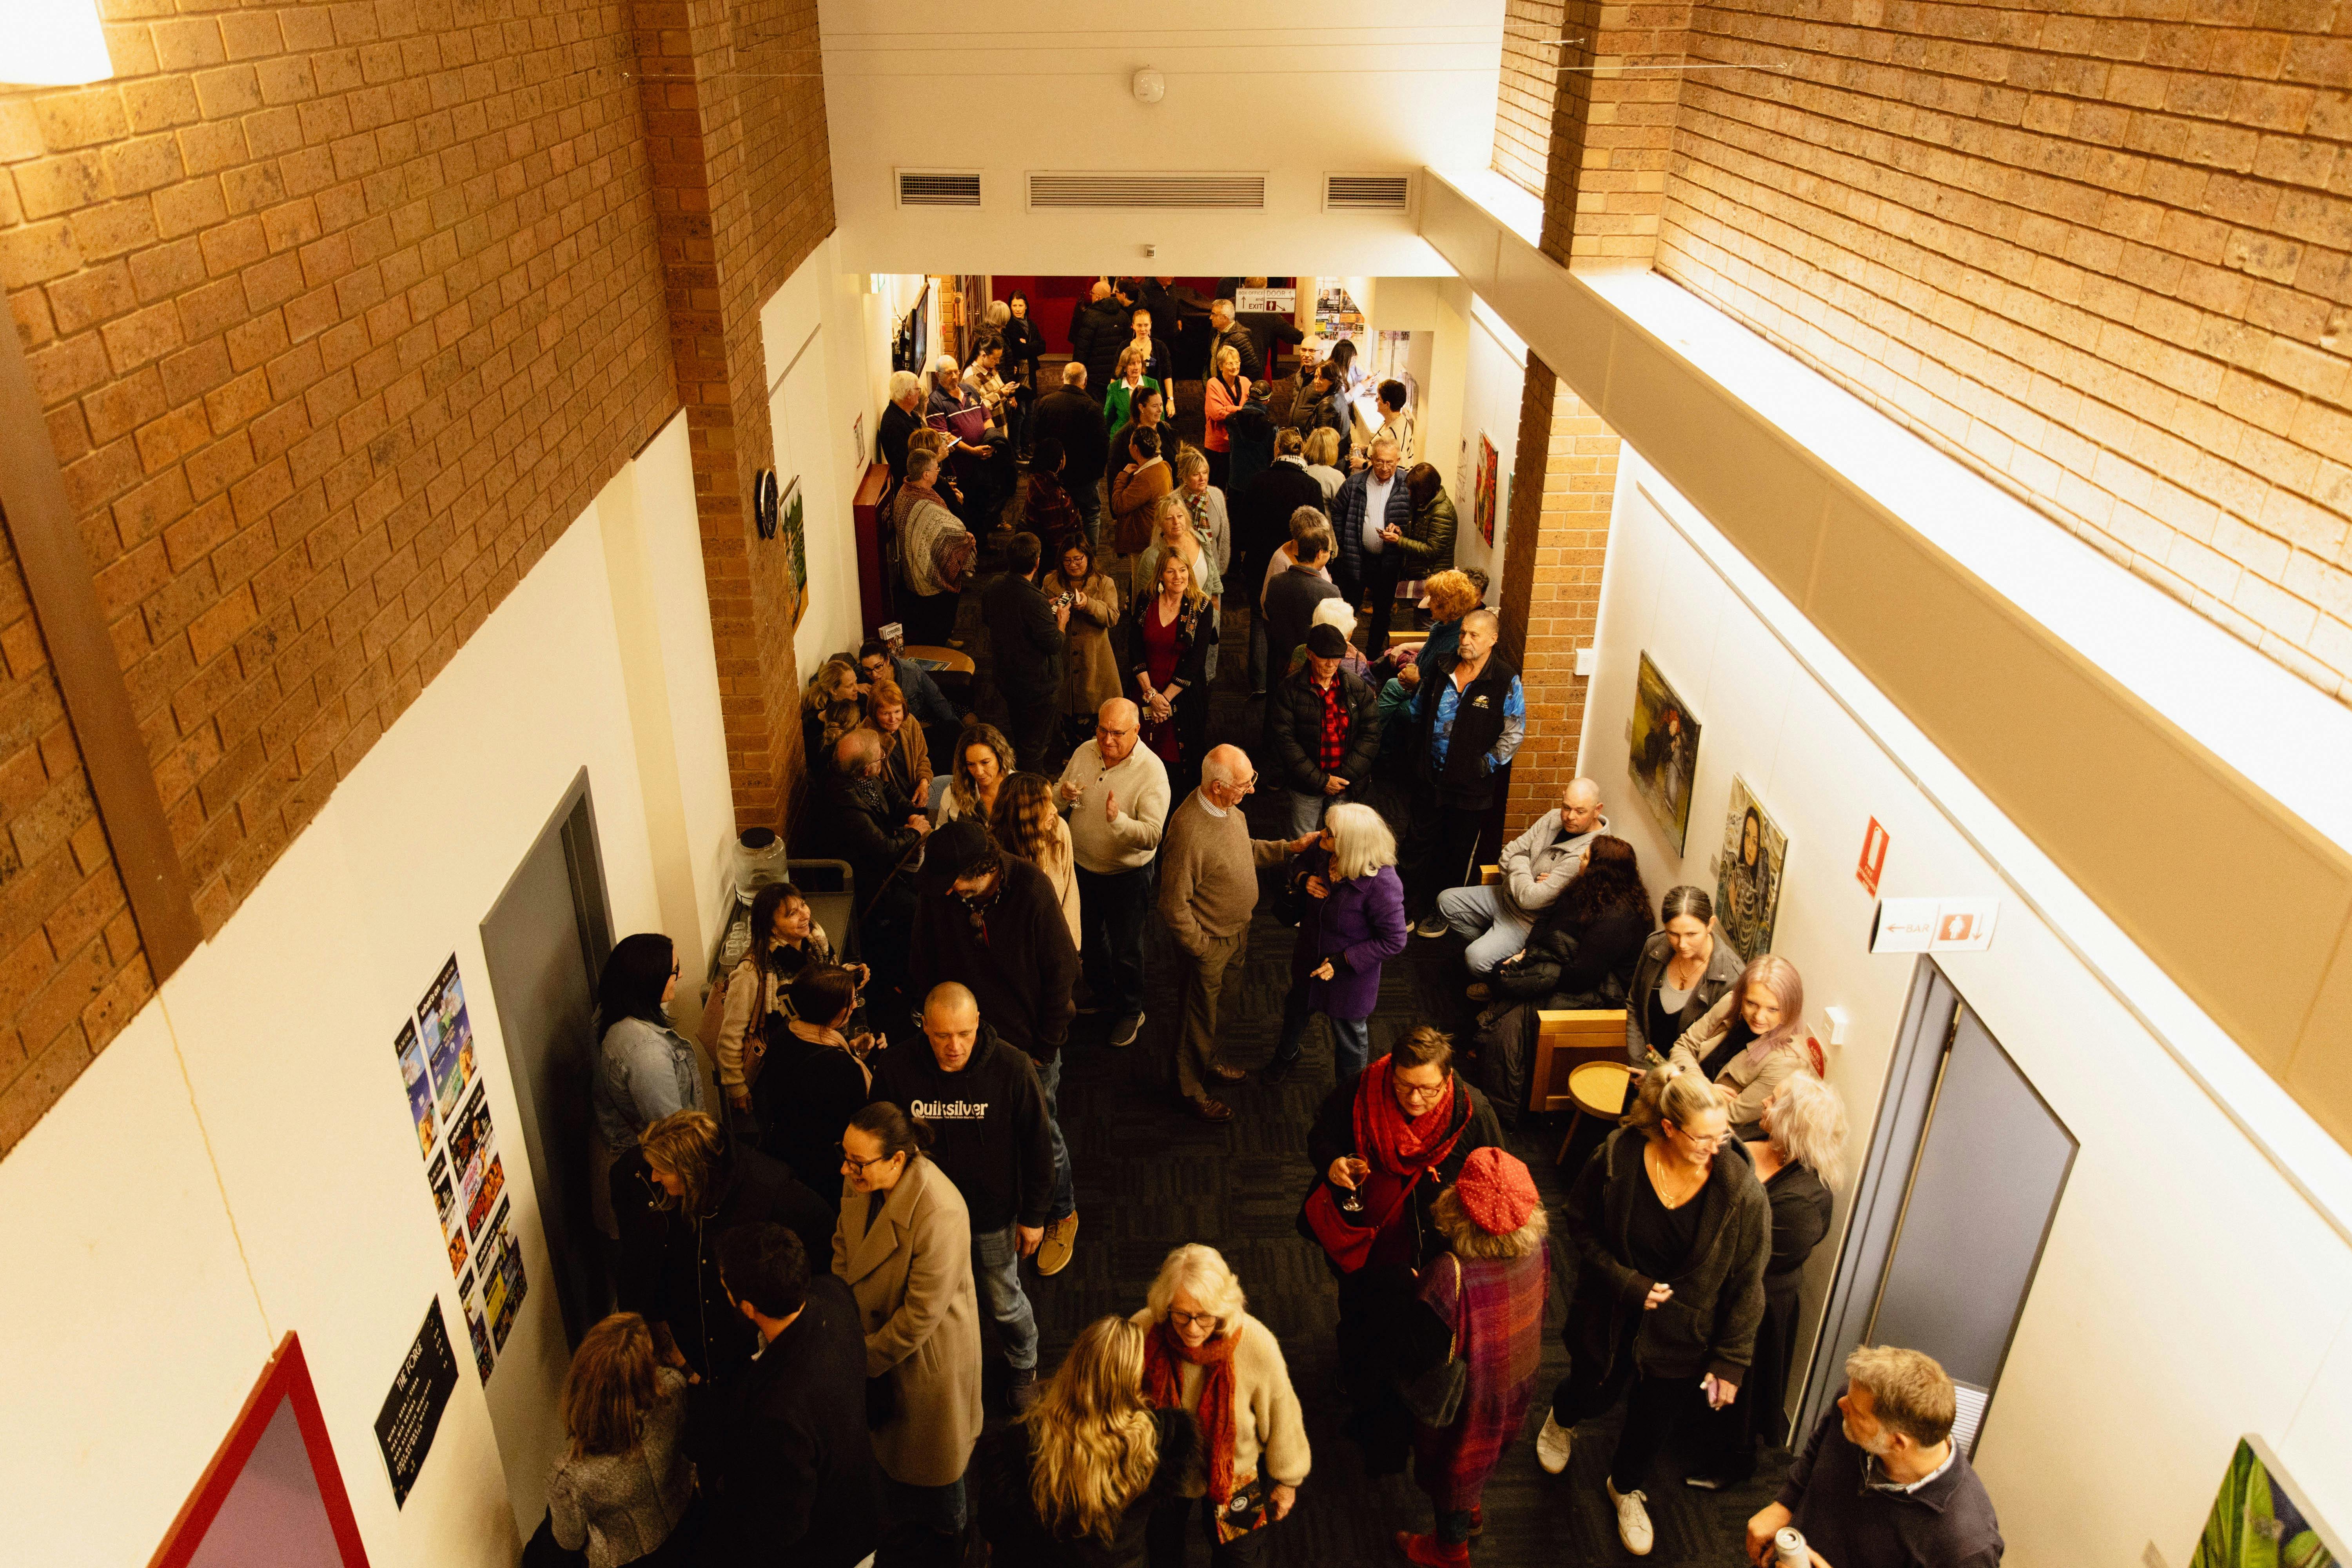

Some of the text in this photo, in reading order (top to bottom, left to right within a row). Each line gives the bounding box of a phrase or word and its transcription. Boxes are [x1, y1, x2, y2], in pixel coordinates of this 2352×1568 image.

[887, 627, 901, 635] create.
[1906, 924, 1929, 933] BAR
[434, 984, 441, 996] on
[911, 1100, 988, 1118] Quiksilver
[463, 1111, 469, 1123] on
[490, 1229, 495, 1240] on
[397, 1338, 423, 1392] THE FORGE
[409, 1377, 419, 1396] CIDER
